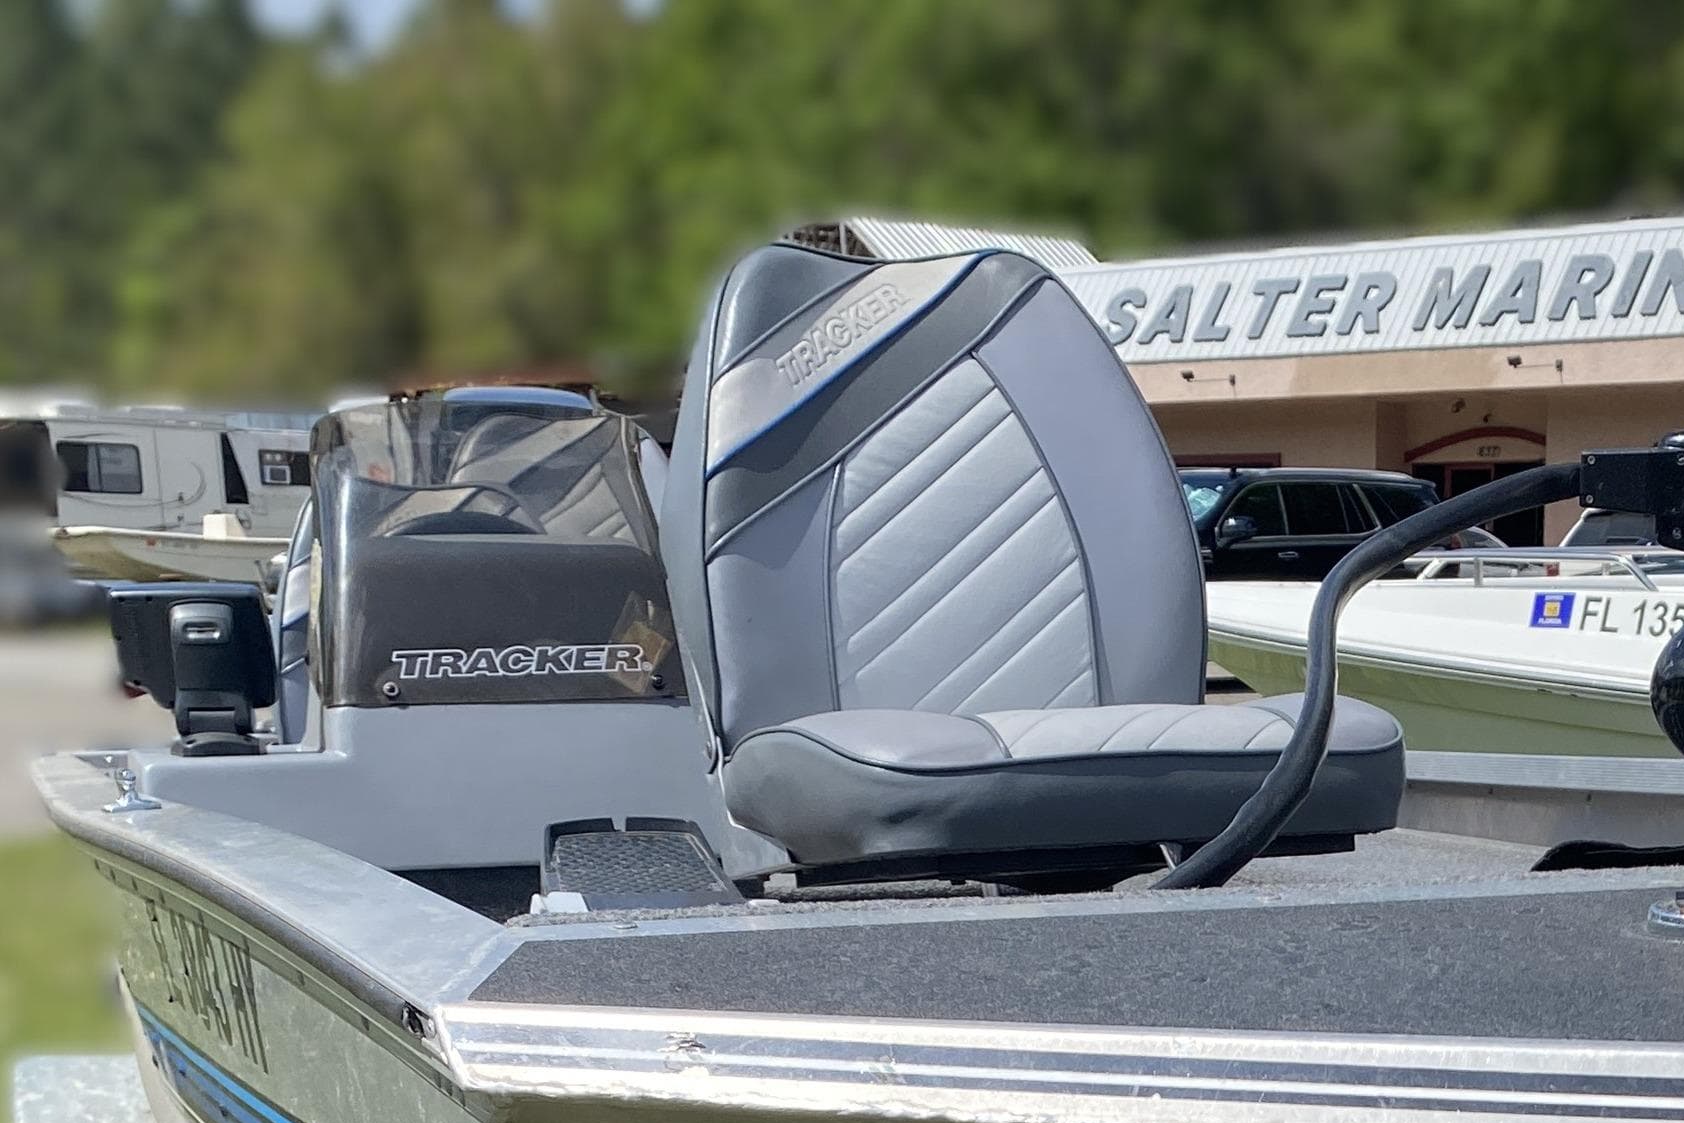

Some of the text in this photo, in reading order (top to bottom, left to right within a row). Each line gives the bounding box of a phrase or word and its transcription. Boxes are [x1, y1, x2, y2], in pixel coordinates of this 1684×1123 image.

[775, 283, 912, 388] TRACKER
[1106, 271, 1397, 346] SALTER
[1579, 596, 1618, 633] FL
[392, 644, 646, 680] TRACKER
